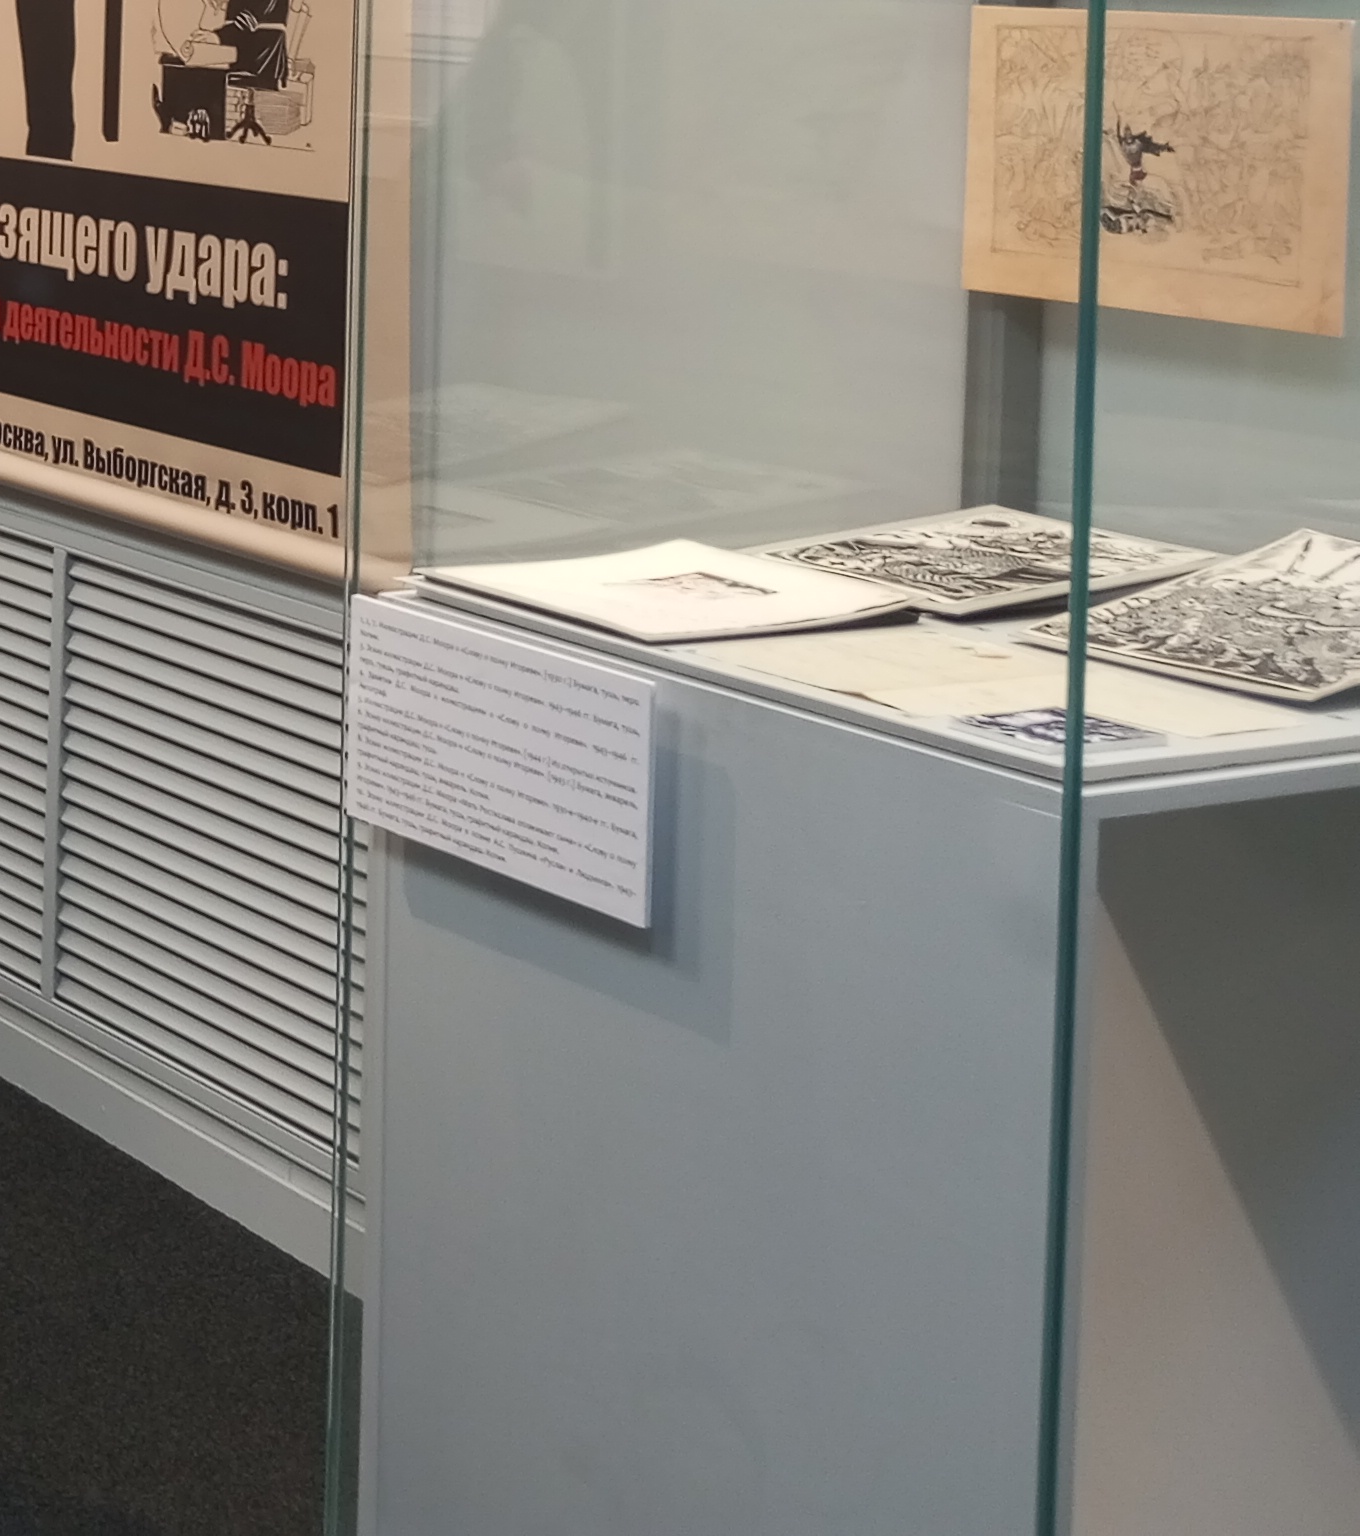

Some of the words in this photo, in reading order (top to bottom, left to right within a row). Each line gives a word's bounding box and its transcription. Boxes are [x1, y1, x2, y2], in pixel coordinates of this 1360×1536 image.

[145, 225, 289, 309] удара:
[2, 300, 179, 373] деятельности
[184, 329, 235, 386] Д.С.
[241, 340, 336, 407] Моора
[51, 435, 79, 467] ул.
[83, 438, 211, 506] Выборгская,
[214, 479, 236, 514] д.
[240, 480, 258, 520] 3,
[262, 491, 324, 534] корп.
[327, 503, 340, 538] 1
